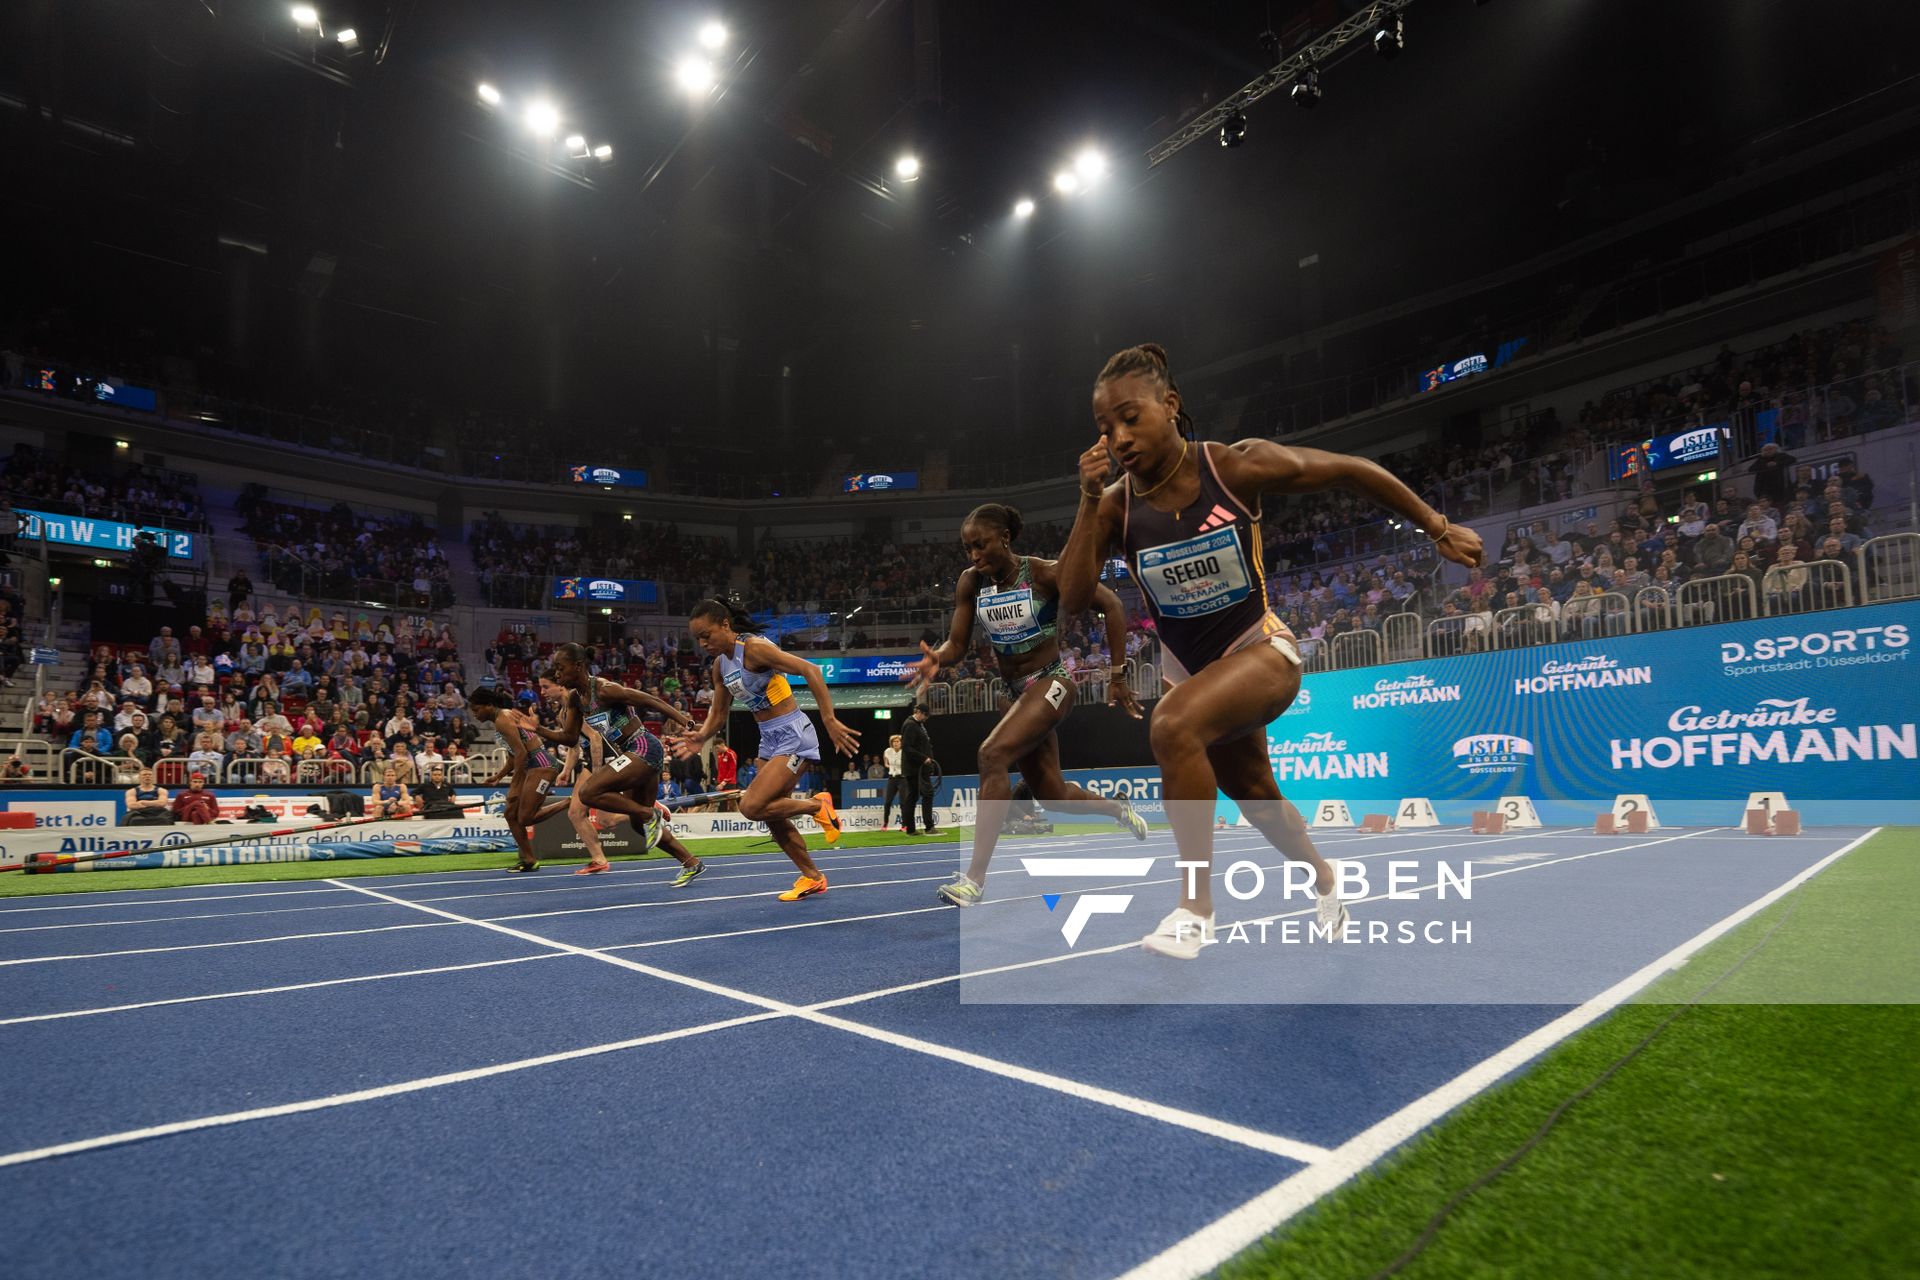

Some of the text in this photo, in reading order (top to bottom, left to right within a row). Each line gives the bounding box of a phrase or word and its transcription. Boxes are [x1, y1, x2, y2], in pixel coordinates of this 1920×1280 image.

[1683, 450, 1718, 461] DÜSSELDOR
[71, 520, 94, 542] W
[174, 535, 189, 555] 2
[1212, 534, 1232, 546] 2024
[1163, 556, 1220, 585] SEEDO
[1170, 581, 1230, 602] HOFFMANN
[986, 604, 1024, 622] KWAYIE
[1178, 595, 1231, 615] D.SPORTS
[1721, 624, 1910, 663] D.SPORTS
[826, 665, 834, 677] 2
[1542, 655, 1618, 675] Getränke
[1724, 649, 1910, 677] Sportstadt Düsseldorf
[1374, 675, 1435, 692] Getränke
[1515, 666, 1652, 695] HOFFMANN
[1052, 687, 1061, 701] 2
[1353, 685, 1461, 709] HOFFMANN
[1668, 697, 1837, 732] Getränke
[1469, 739, 1515, 755] ISTAF
[1610, 723, 1918, 769] HOFFMANN
[616, 759, 626, 767] 4
[1269, 752, 1389, 781] FMANN
[1064, 778, 1162, 799] SPORT
[1132, 801, 1164, 813] üsseld
[1322, 805, 1335, 821] 5
[1402, 802, 1417, 820] 4
[1504, 801, 1520, 820] 3
[1621, 799, 1638, 820] 2
[35, 814, 107, 828] ett1.de
[664, 821, 692, 833] ben.
[711, 819, 754, 832] Allianz
[849, 815, 882, 827] Leben.
[60, 837, 153, 851] Allianz
[306, 831, 352, 844] dein
